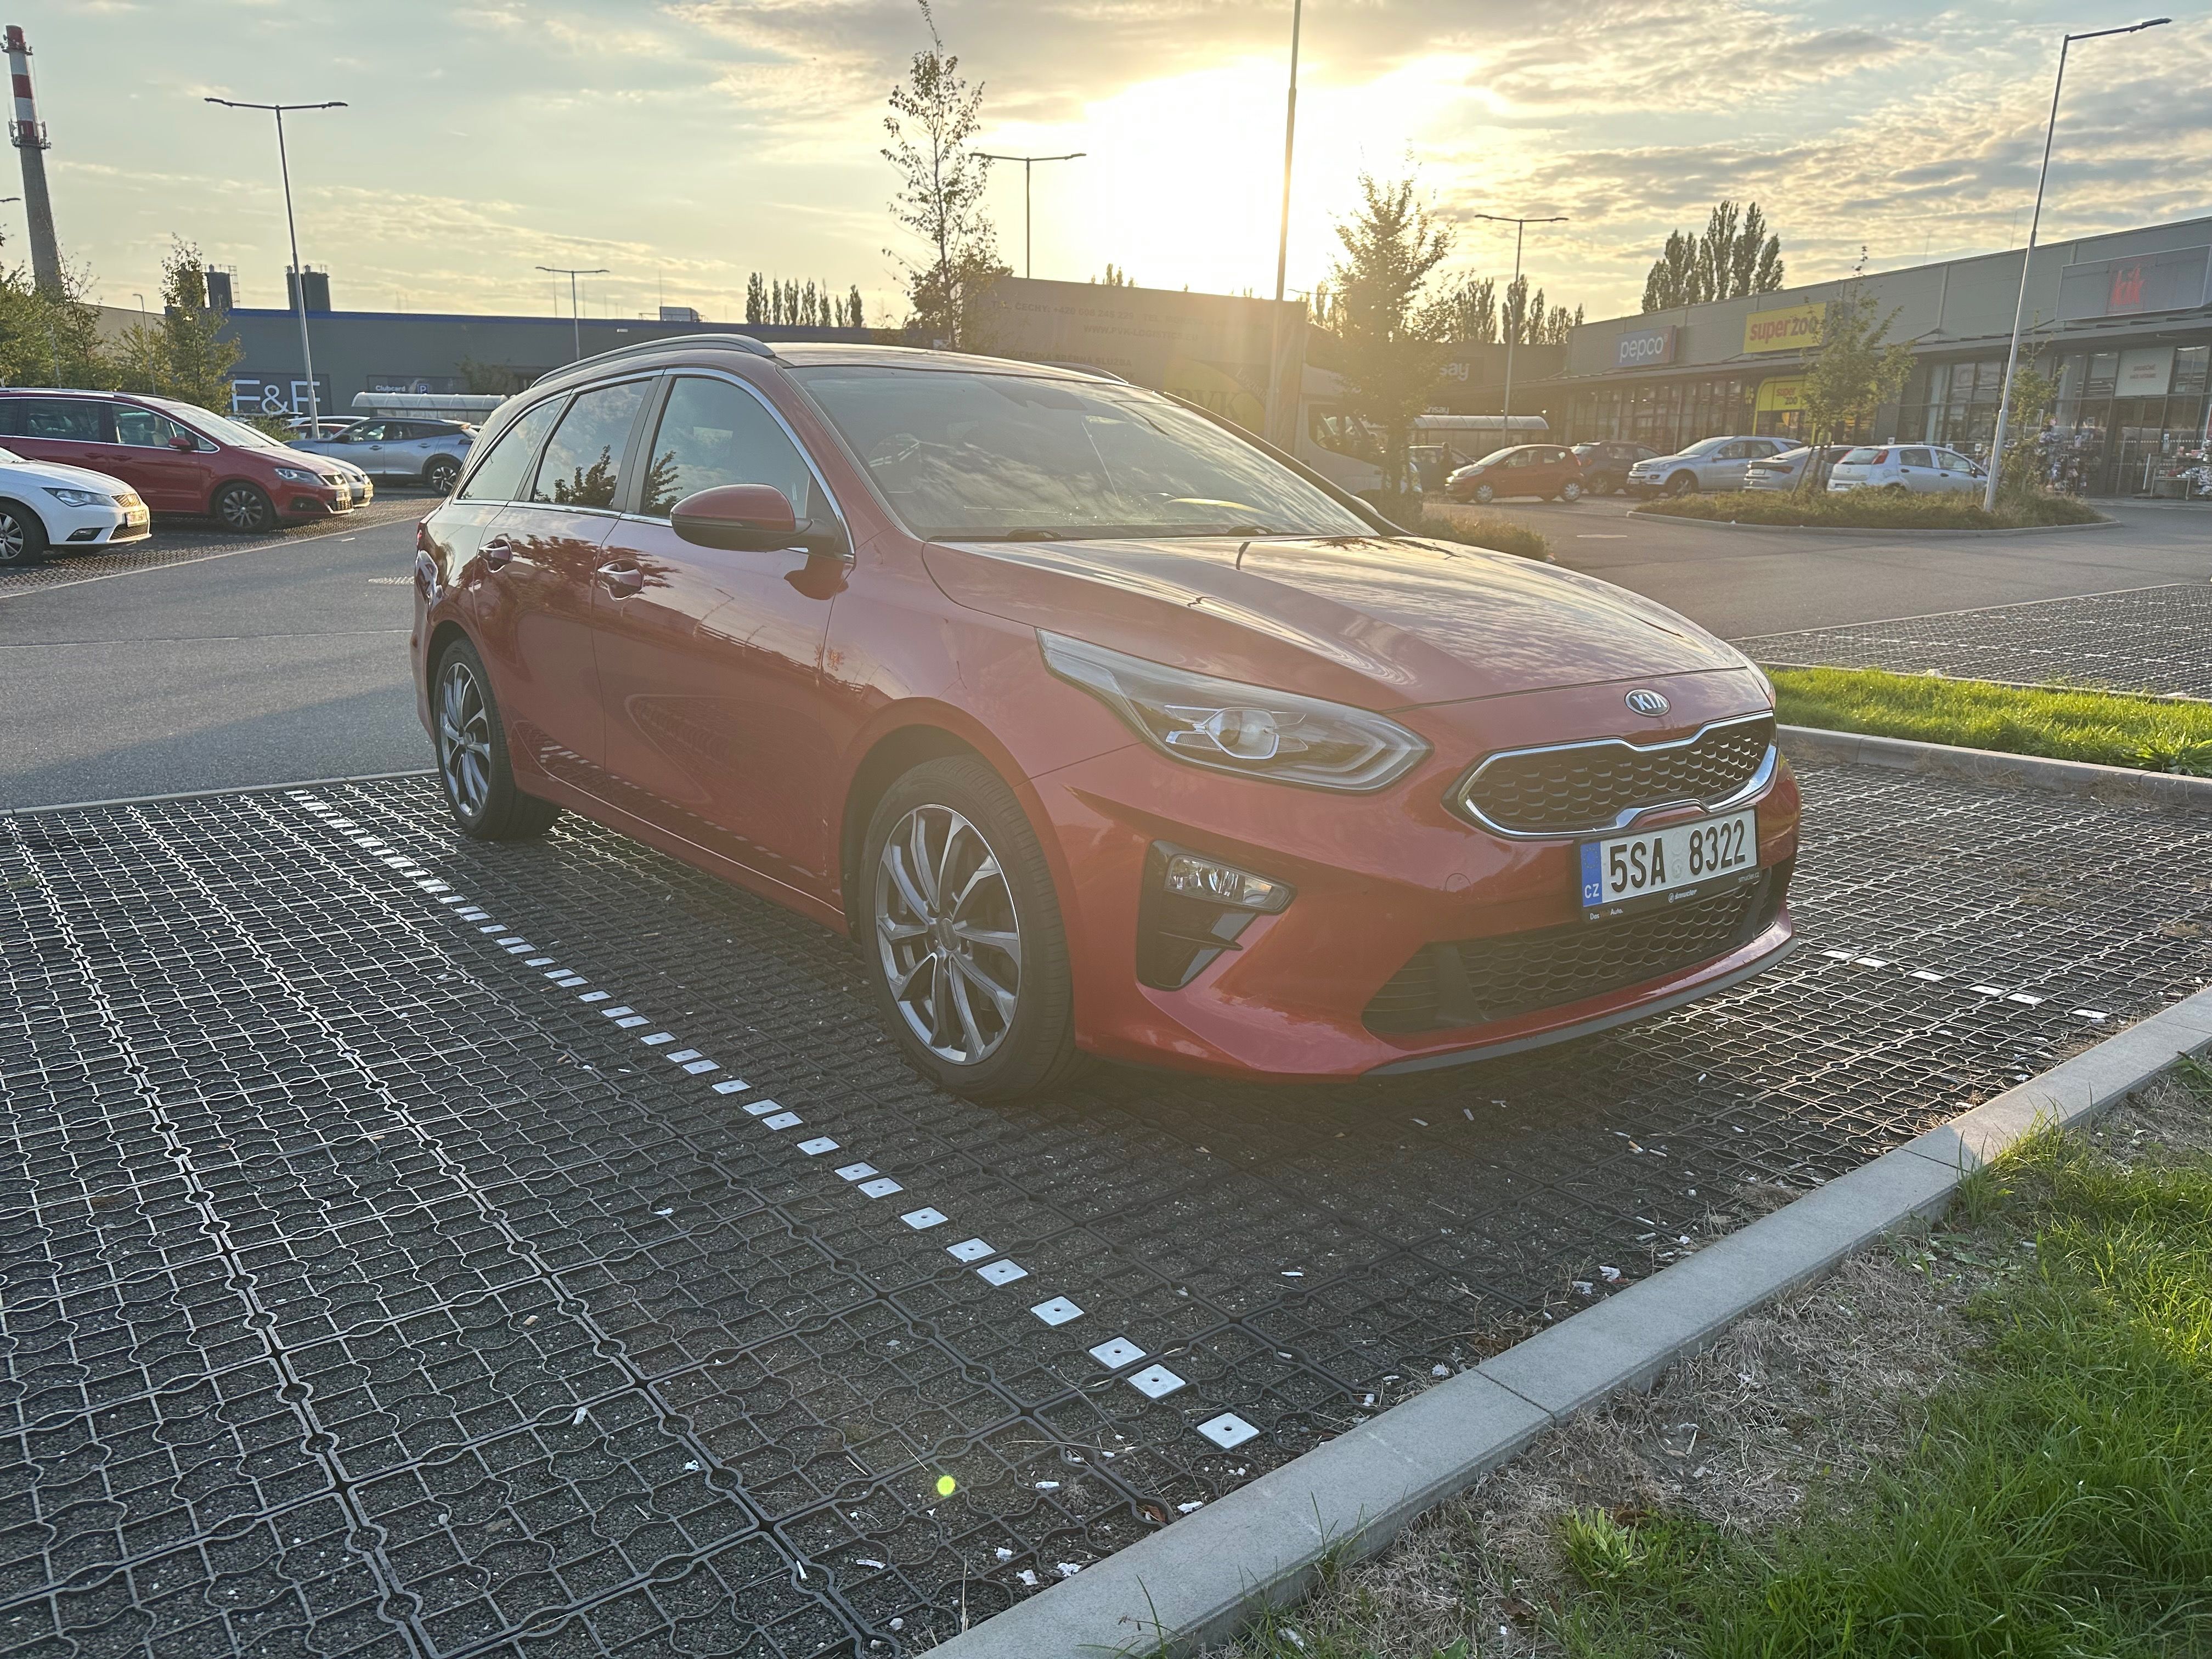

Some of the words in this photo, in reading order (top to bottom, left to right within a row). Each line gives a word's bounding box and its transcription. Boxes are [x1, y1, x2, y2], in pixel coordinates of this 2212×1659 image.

[1053, 307, 1076, 315] +420
[1620, 336, 1664, 363] pepco
[232, 379, 320, 415] F&F
[1632, 692, 1668, 710] KIA
[1610, 837, 1666, 893] 5SA
[1689, 819, 1746, 875] 8322
[1584, 883, 1599, 899] CZ
